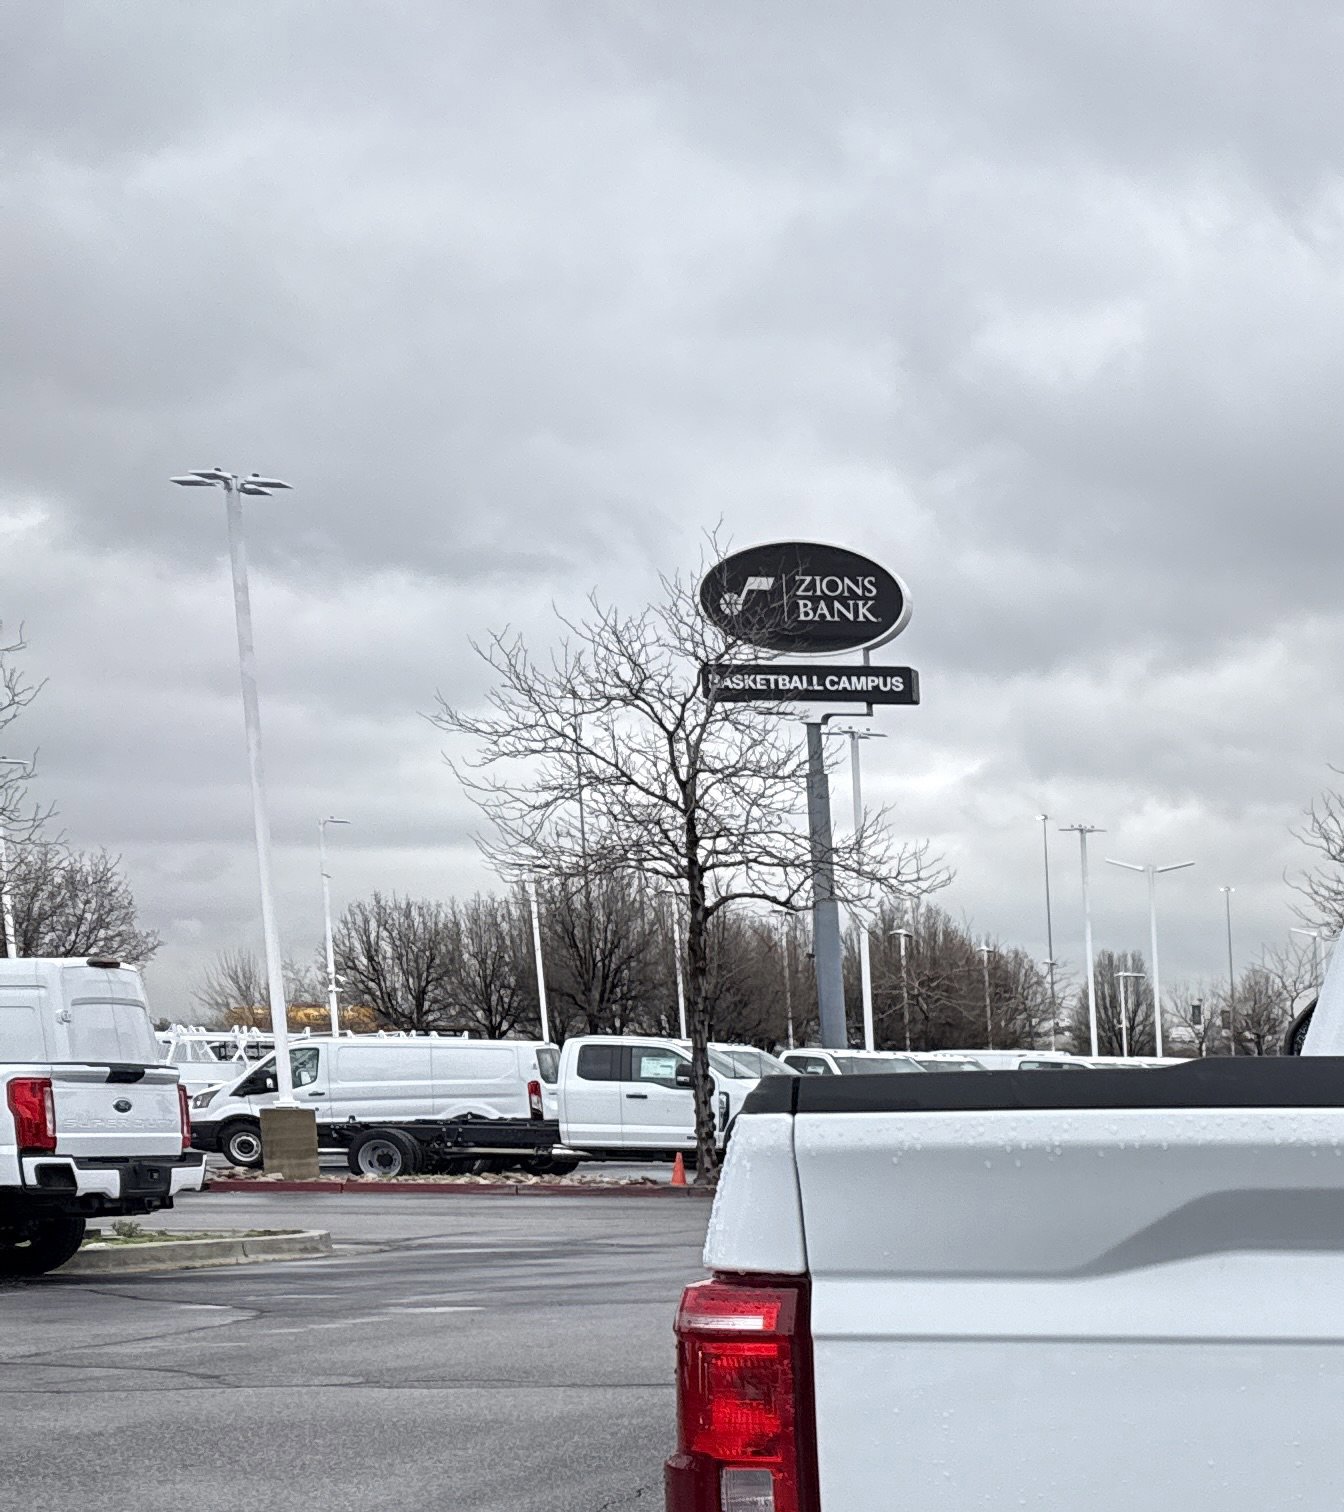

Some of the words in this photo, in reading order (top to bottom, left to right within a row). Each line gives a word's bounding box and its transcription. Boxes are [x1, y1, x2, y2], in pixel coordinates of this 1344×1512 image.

[795, 576, 877, 597] ZIONS
[797, 600, 879, 622] BANK
[825, 676, 904, 691] CAMPUS
[64, 1118, 131, 1129] SUPER
